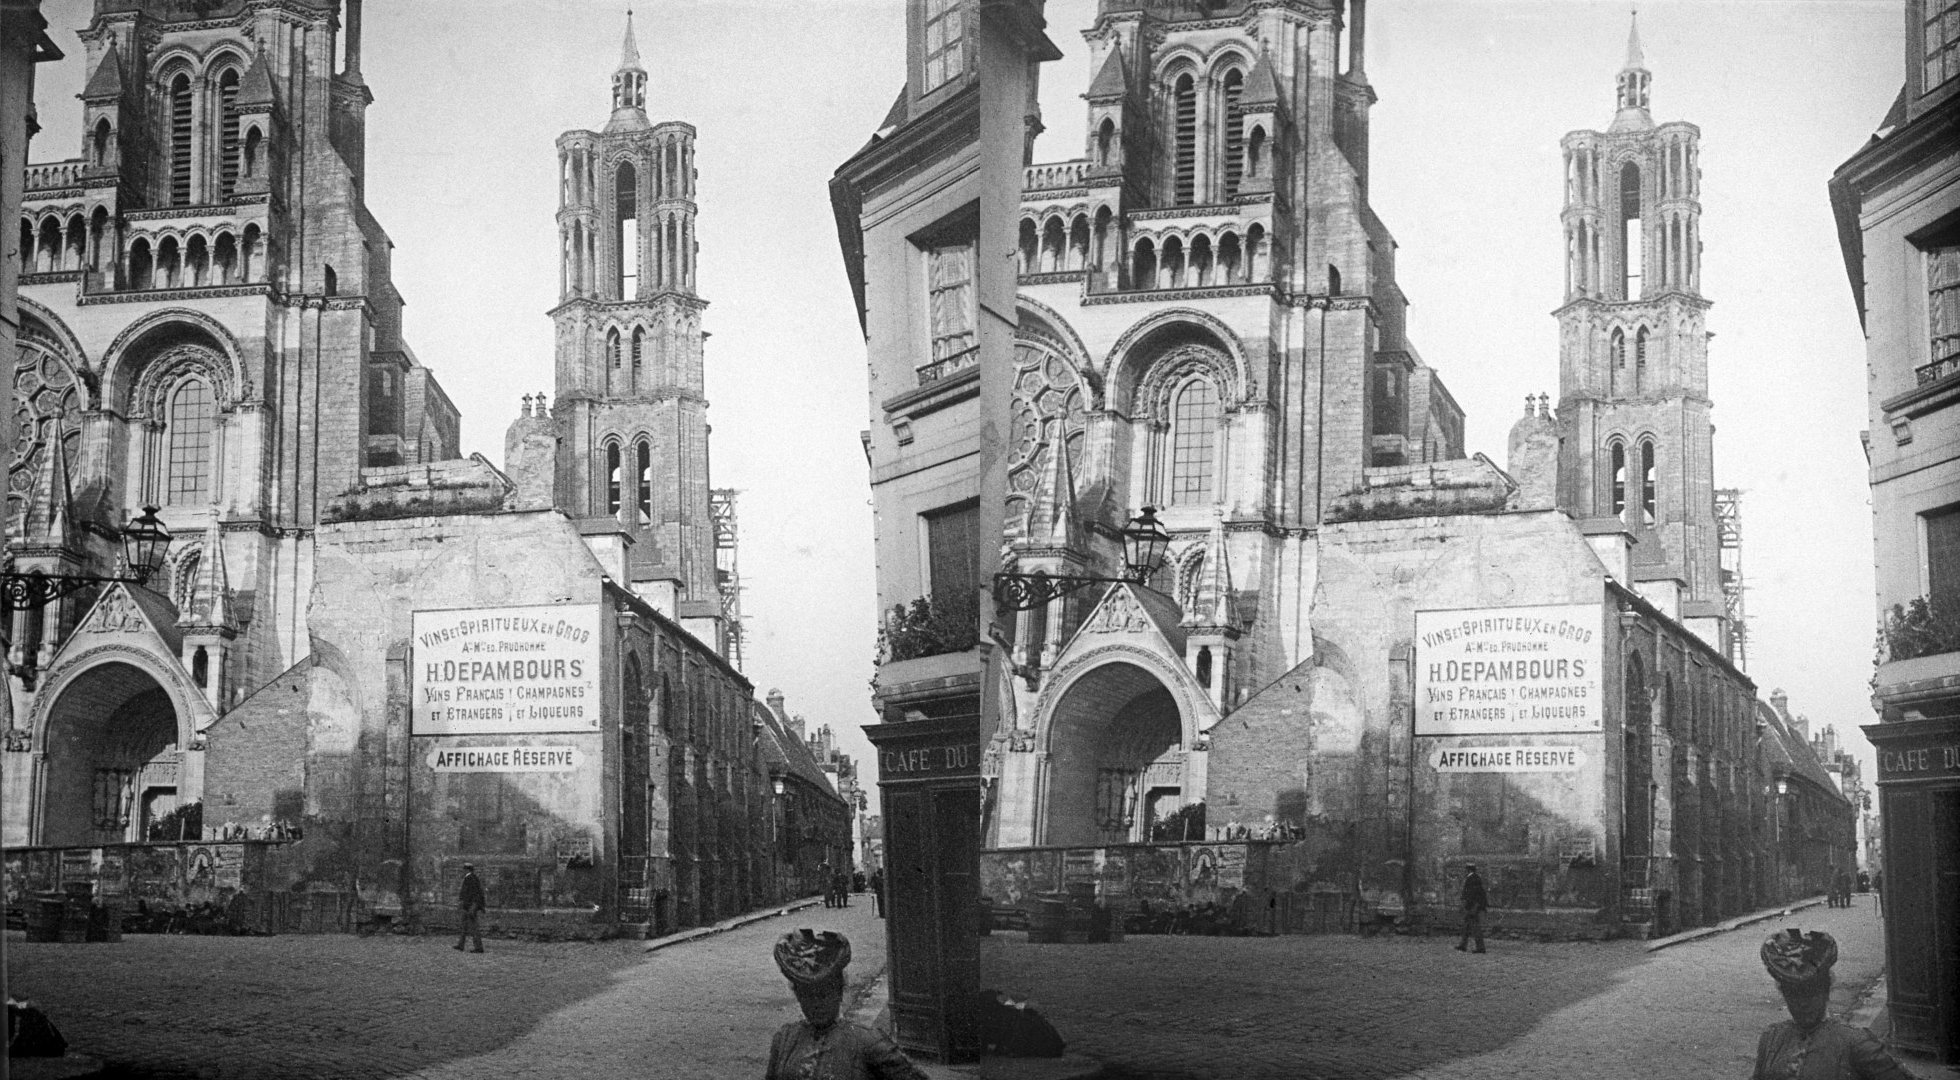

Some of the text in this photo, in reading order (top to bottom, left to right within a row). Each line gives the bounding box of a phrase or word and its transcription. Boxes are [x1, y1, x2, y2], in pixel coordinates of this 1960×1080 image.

[420, 628, 450, 648] VINS
[460, 617, 540, 636] SPIRITUEUX
[541, 622, 554, 634] EN
[556, 619, 590, 644] GROS
[1422, 629, 1452, 649] VINS
[1462, 617, 1542, 636] SPIRITUEUX
[1558, 619, 1592, 644] GROS
[498, 640, 546, 653] PRUDHOMME
[444, 659, 582, 682] DEPAMBOURS
[1446, 659, 1586, 682] DEPAMBOURS
[424, 686, 451, 704] VINS
[516, 686, 585, 700] CHAMPAGNES
[1427, 687, 1453, 704] VINS
[1519, 686, 1587, 700] CHAMPAGNES
[431, 711, 441, 721] ET
[516, 705, 583, 720] ET LIQUEURS
[1434, 711, 1444, 721] ET
[1519, 705, 1586, 720] ET LIQUEURS
[436, 750, 509, 767] AFFICHAGE
[945, 746, 968, 769] DU
[1439, 750, 1512, 767] AFFICHAGE
